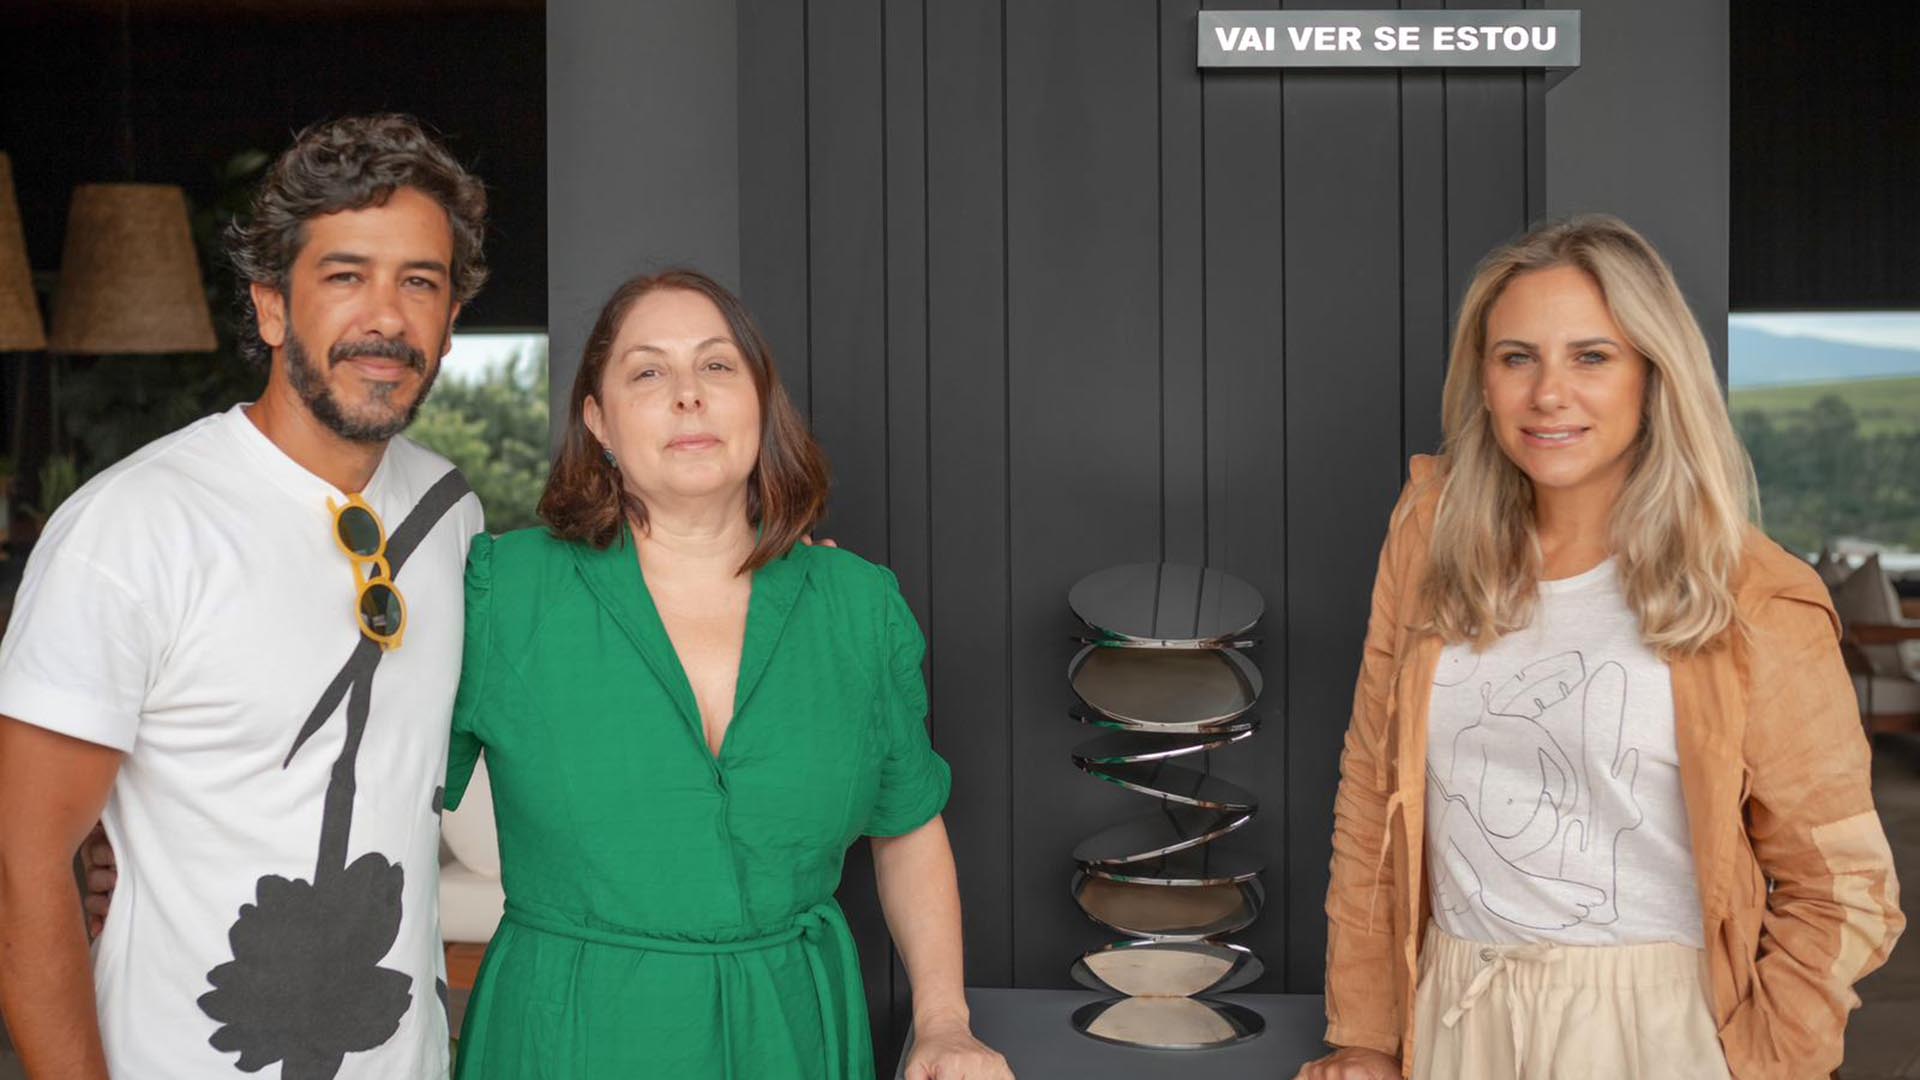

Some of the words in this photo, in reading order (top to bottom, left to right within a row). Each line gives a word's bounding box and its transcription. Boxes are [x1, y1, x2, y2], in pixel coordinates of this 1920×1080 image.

[1215, 26, 1275, 51] VAI
[1288, 26, 1362, 51] VER
[1374, 26, 1420, 51] SE
[1433, 26, 1556, 51] ESTOU
